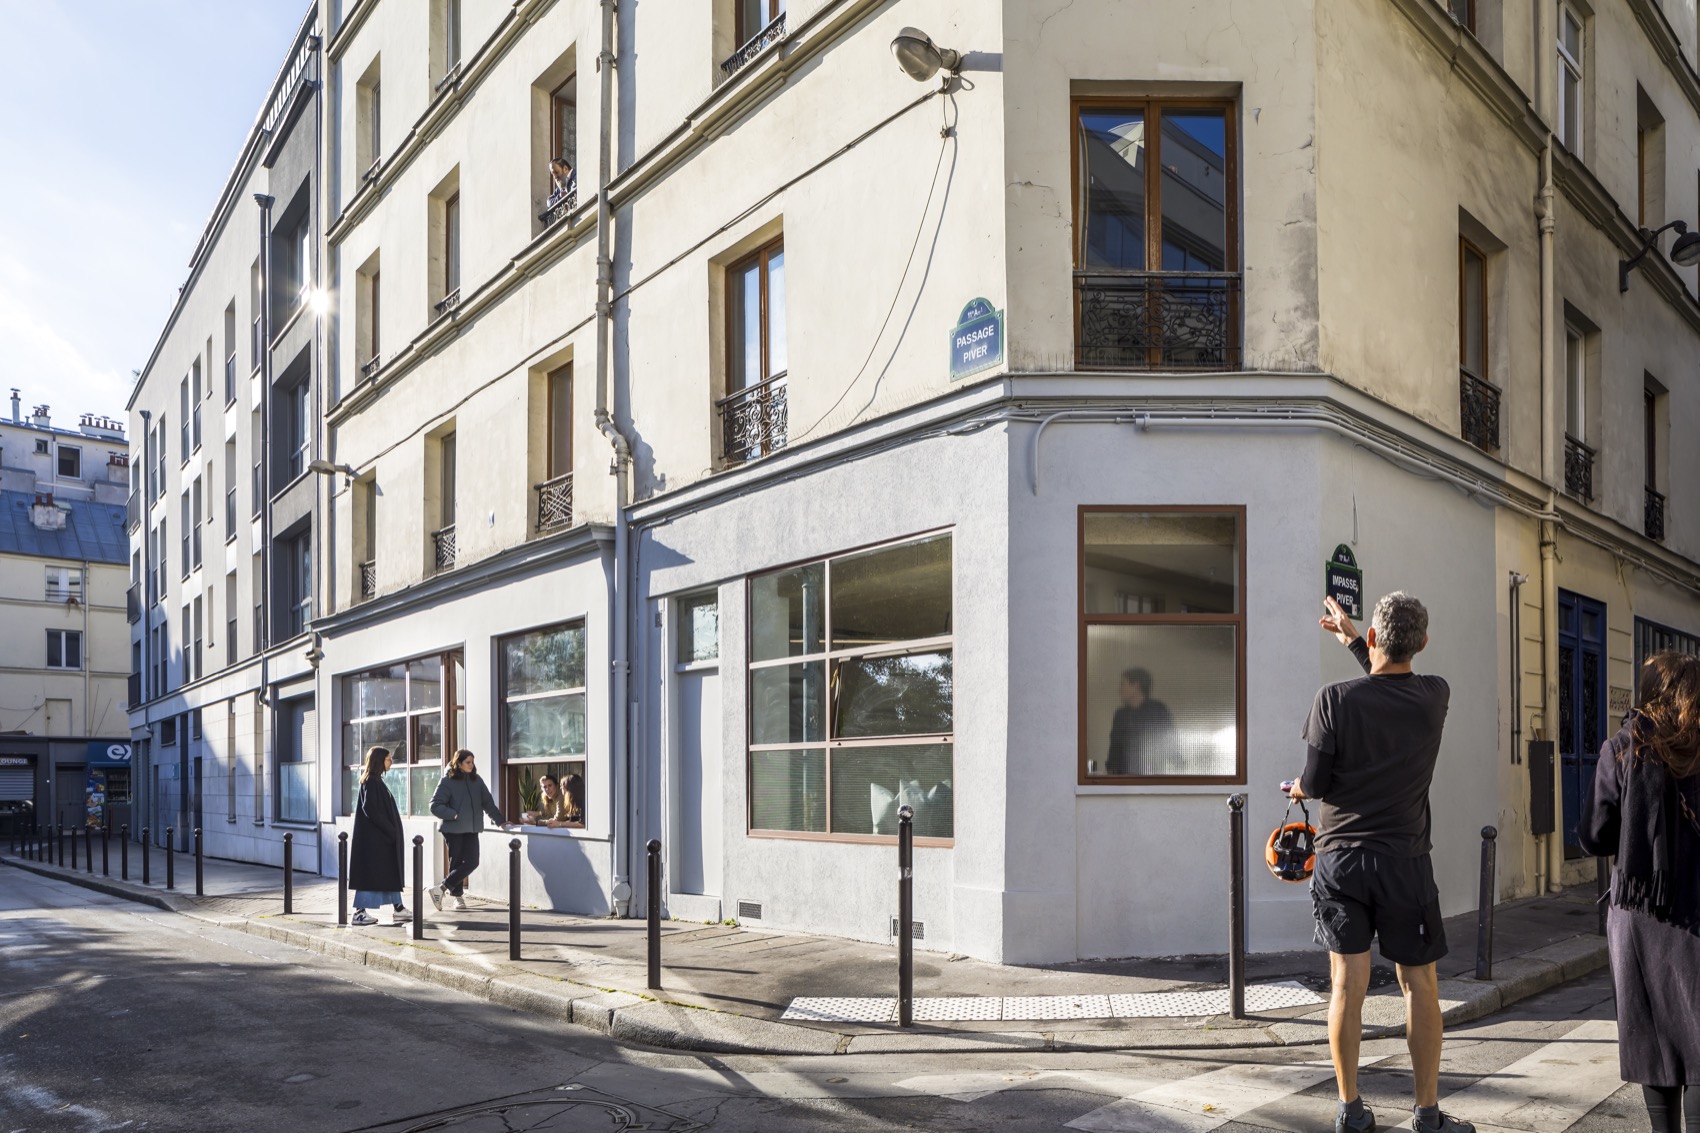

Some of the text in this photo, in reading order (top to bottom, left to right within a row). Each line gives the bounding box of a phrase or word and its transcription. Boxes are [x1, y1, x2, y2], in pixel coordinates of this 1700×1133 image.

[956, 325, 995, 349] PASSAGE
[963, 345, 988, 364] PIVER
[1332, 574, 1357, 590] IMPASSE
[1336, 592, 1354, 606] PIVER
